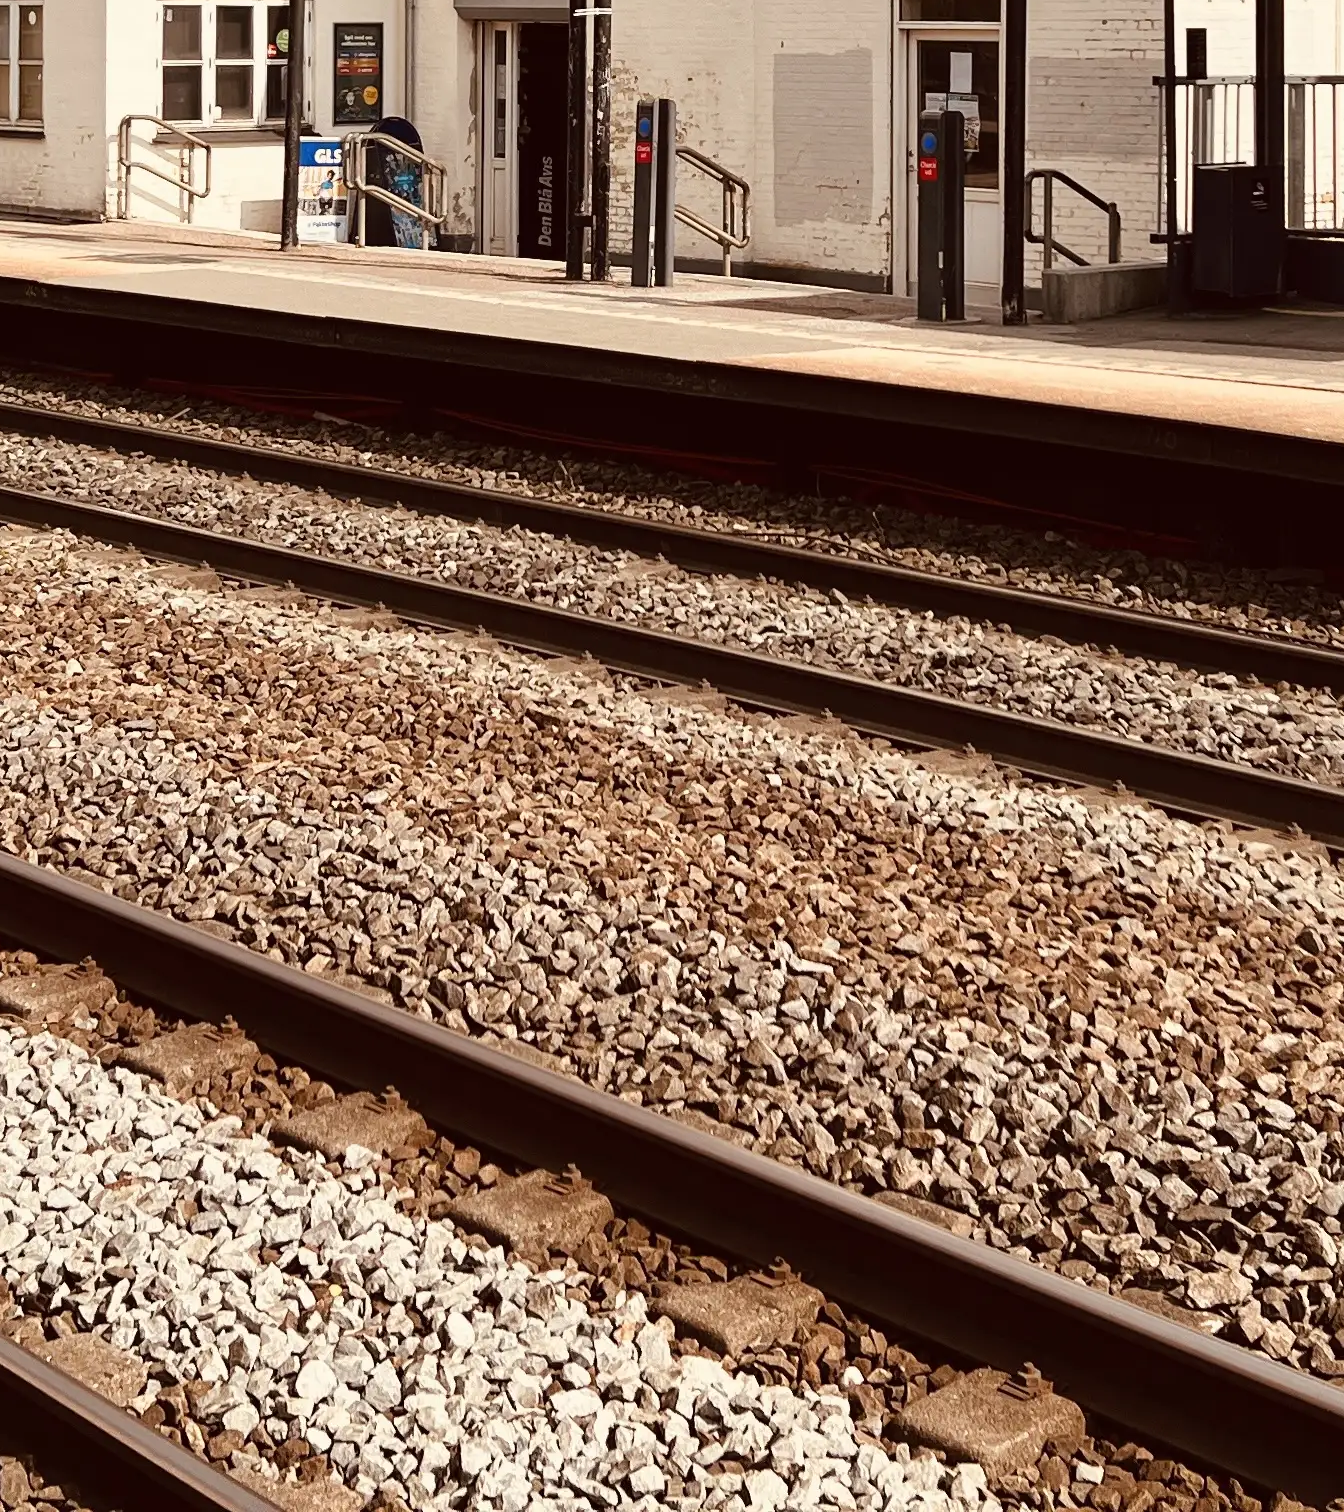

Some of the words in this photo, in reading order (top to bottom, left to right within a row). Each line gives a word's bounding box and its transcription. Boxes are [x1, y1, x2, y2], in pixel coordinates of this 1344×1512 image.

[313, 148, 342, 164] GLS
[538, 156, 553, 188] Avis
[537, 188, 553, 214] Blå
[537, 216, 553, 247] Den
